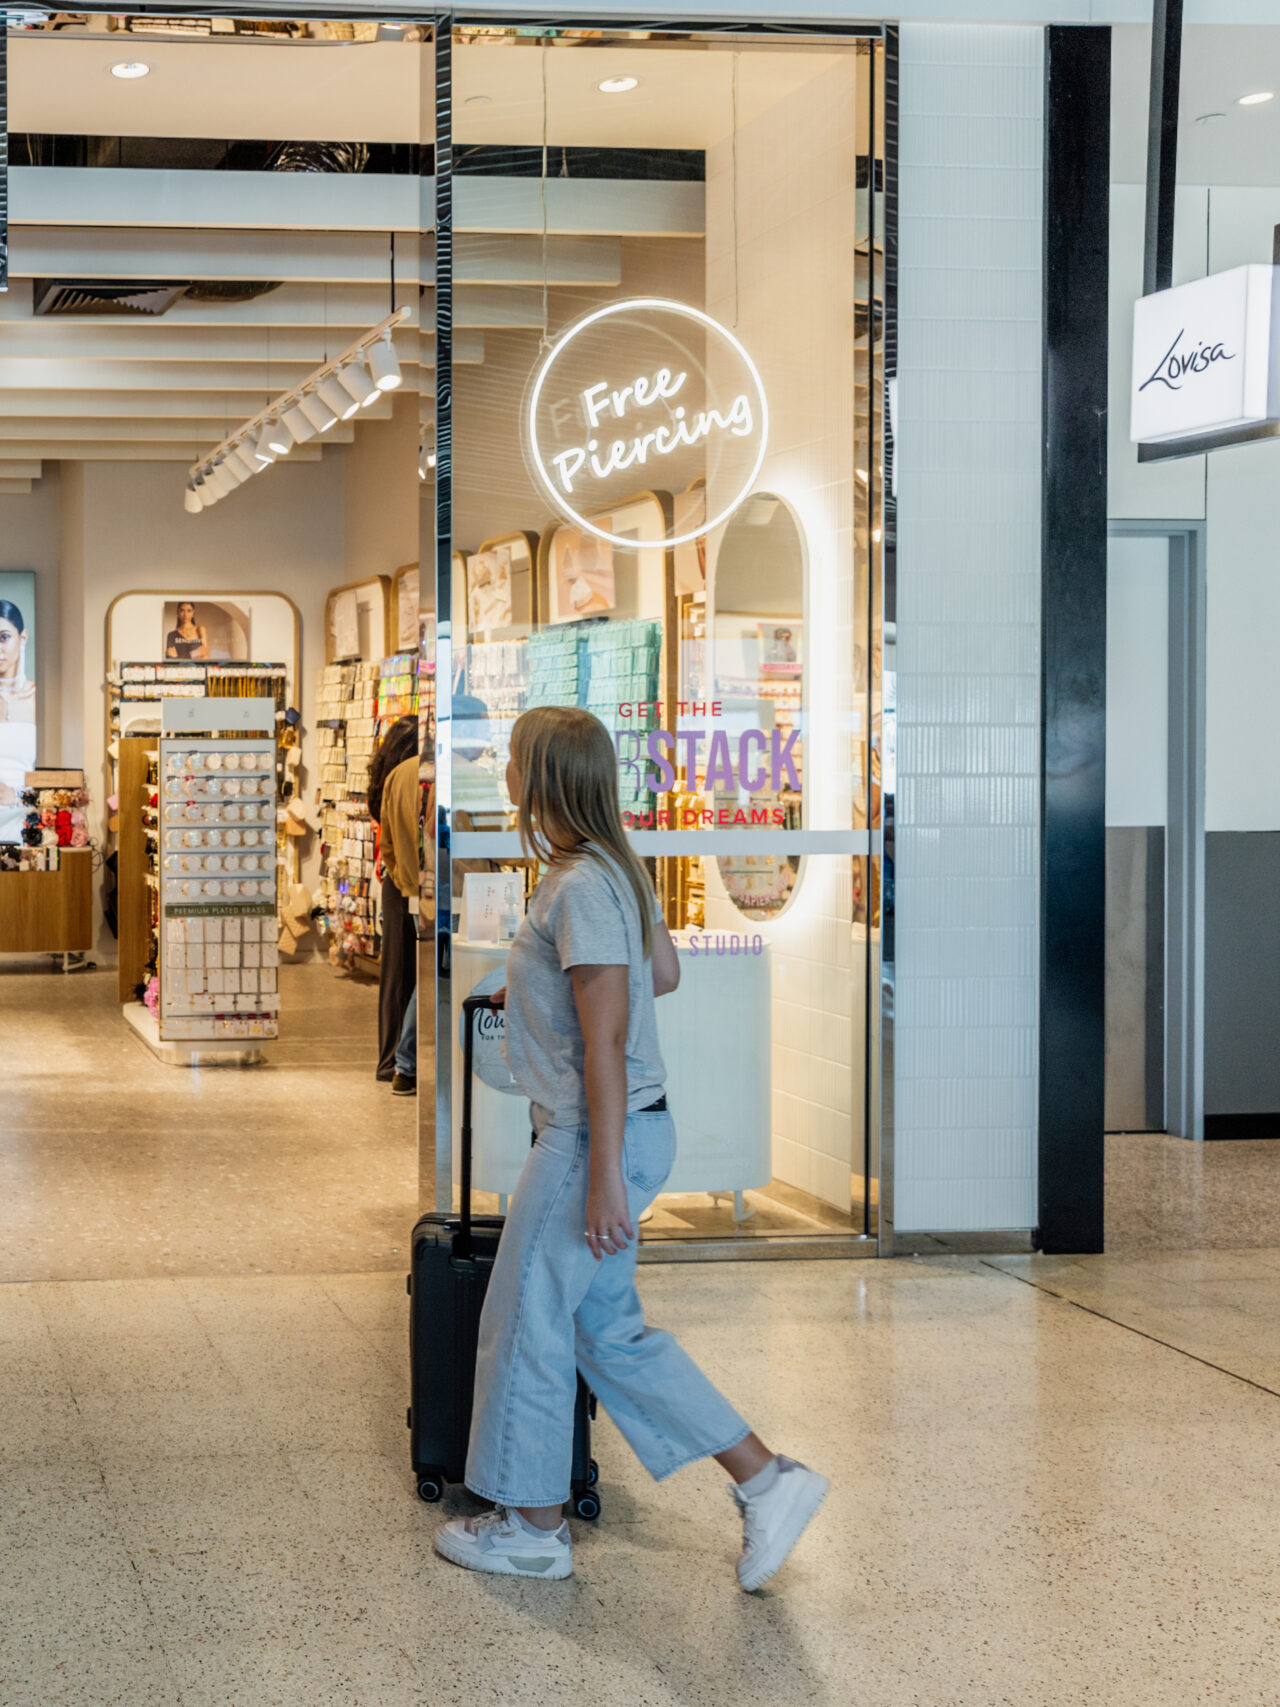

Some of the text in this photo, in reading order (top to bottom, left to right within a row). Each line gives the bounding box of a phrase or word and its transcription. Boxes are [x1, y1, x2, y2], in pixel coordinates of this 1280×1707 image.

[1138, 328, 1237, 391] Lovisa
[583, 368, 687, 427] Free
[552, 394, 754, 494] Piercing
[618, 701, 723, 718] GET THE
[683, 808, 785, 825] DREAMS
[174, 907, 210, 915] PREMIUM
[241, 906, 266, 914] BRASS
[688, 934, 763, 957] STUDIO
